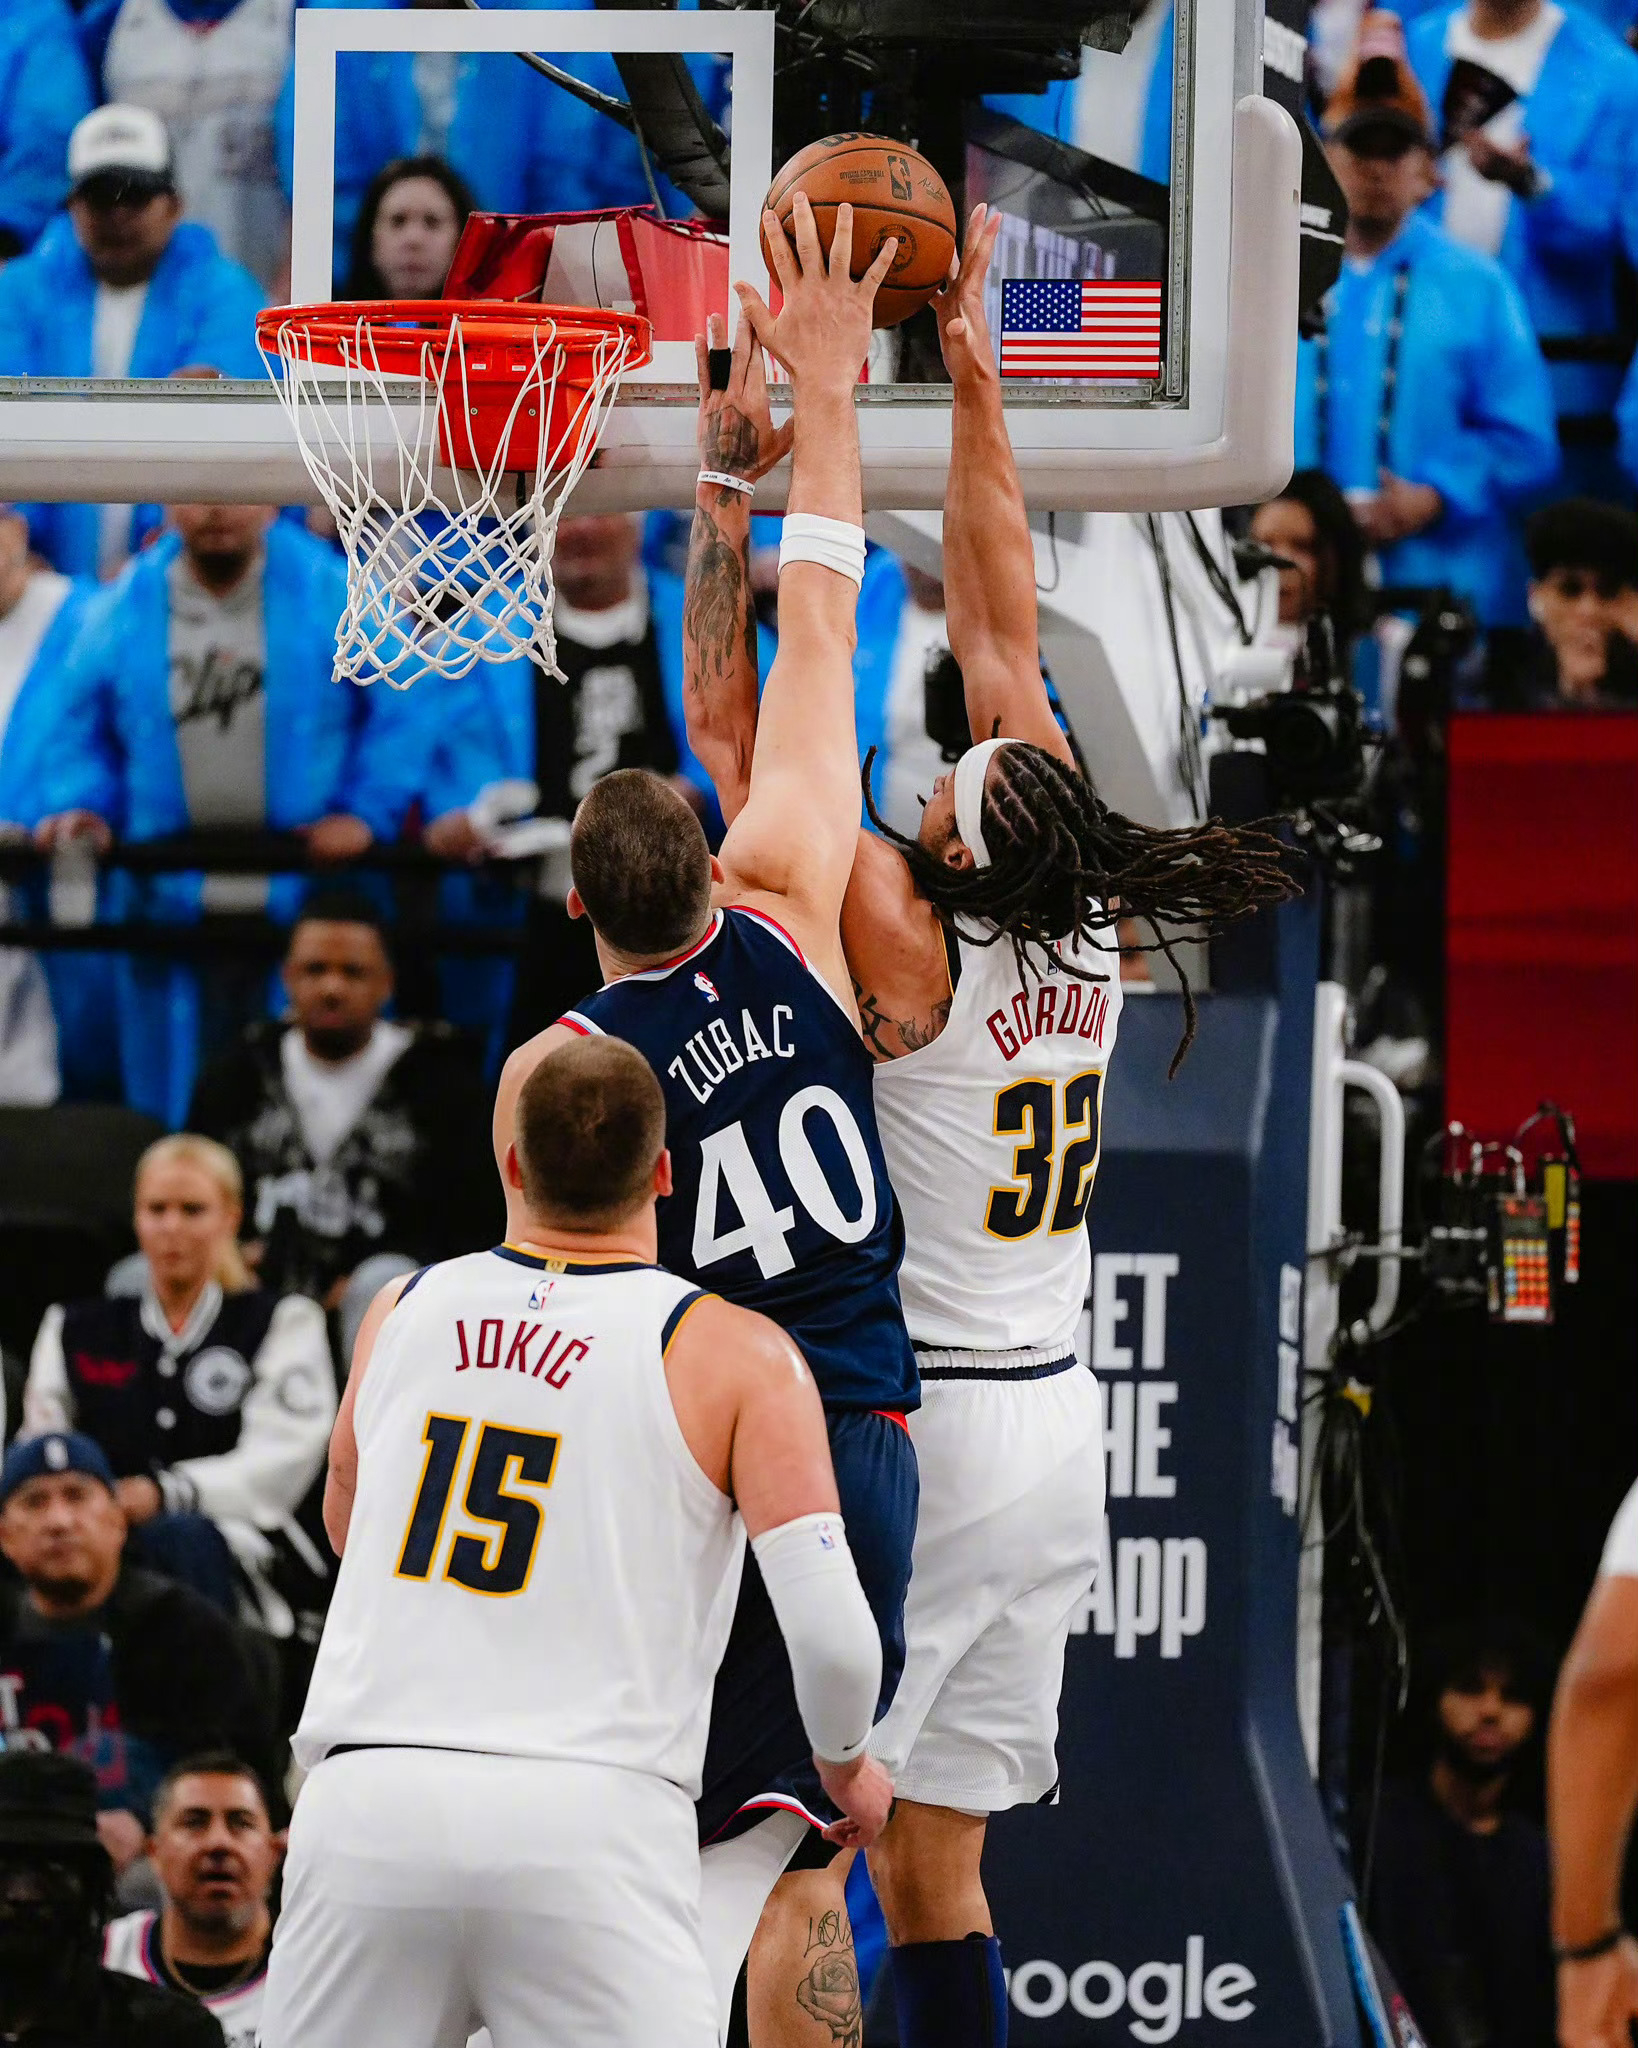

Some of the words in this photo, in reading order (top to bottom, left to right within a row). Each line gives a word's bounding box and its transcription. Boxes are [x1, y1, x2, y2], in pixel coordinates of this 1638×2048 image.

[667, 1004, 796, 1105] ZUBAC
[986, 983, 1110, 1062] GORDON
[691, 1084, 877, 1281] 40
[983, 1069, 1103, 1241] 32
[455, 1318, 595, 1391] JOKIĆ
[1074, 1252, 1180, 1371] ET
[1099, 1381, 1179, 1499] HE
[393, 1410, 563, 1599] 15
[1003, 1934, 1258, 2045] oogle
